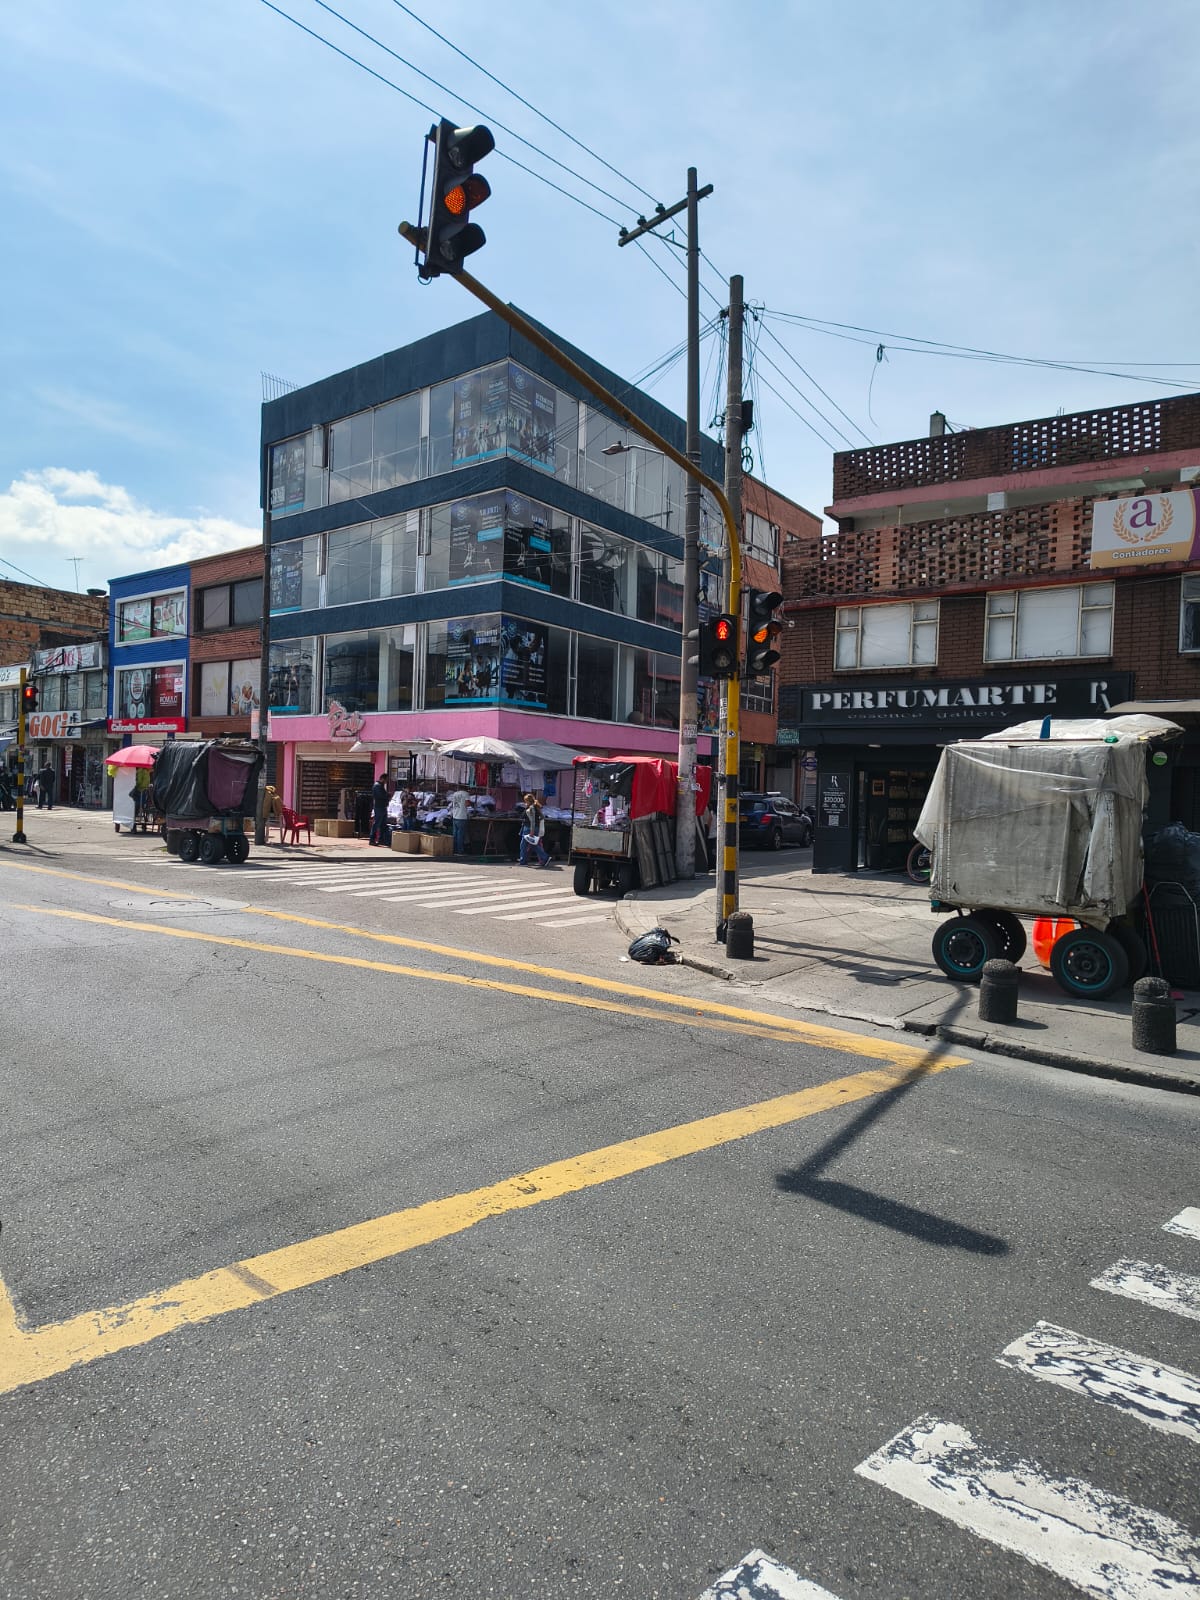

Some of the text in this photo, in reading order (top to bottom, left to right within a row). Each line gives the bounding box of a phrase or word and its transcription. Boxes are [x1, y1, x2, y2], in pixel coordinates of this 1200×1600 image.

[1129, 499, 1156, 528] a
[1112, 547, 1171, 559] Contadores
[812, 684, 1057, 710] PERFUMARTE
[937, 710, 1009, 720] gallery
